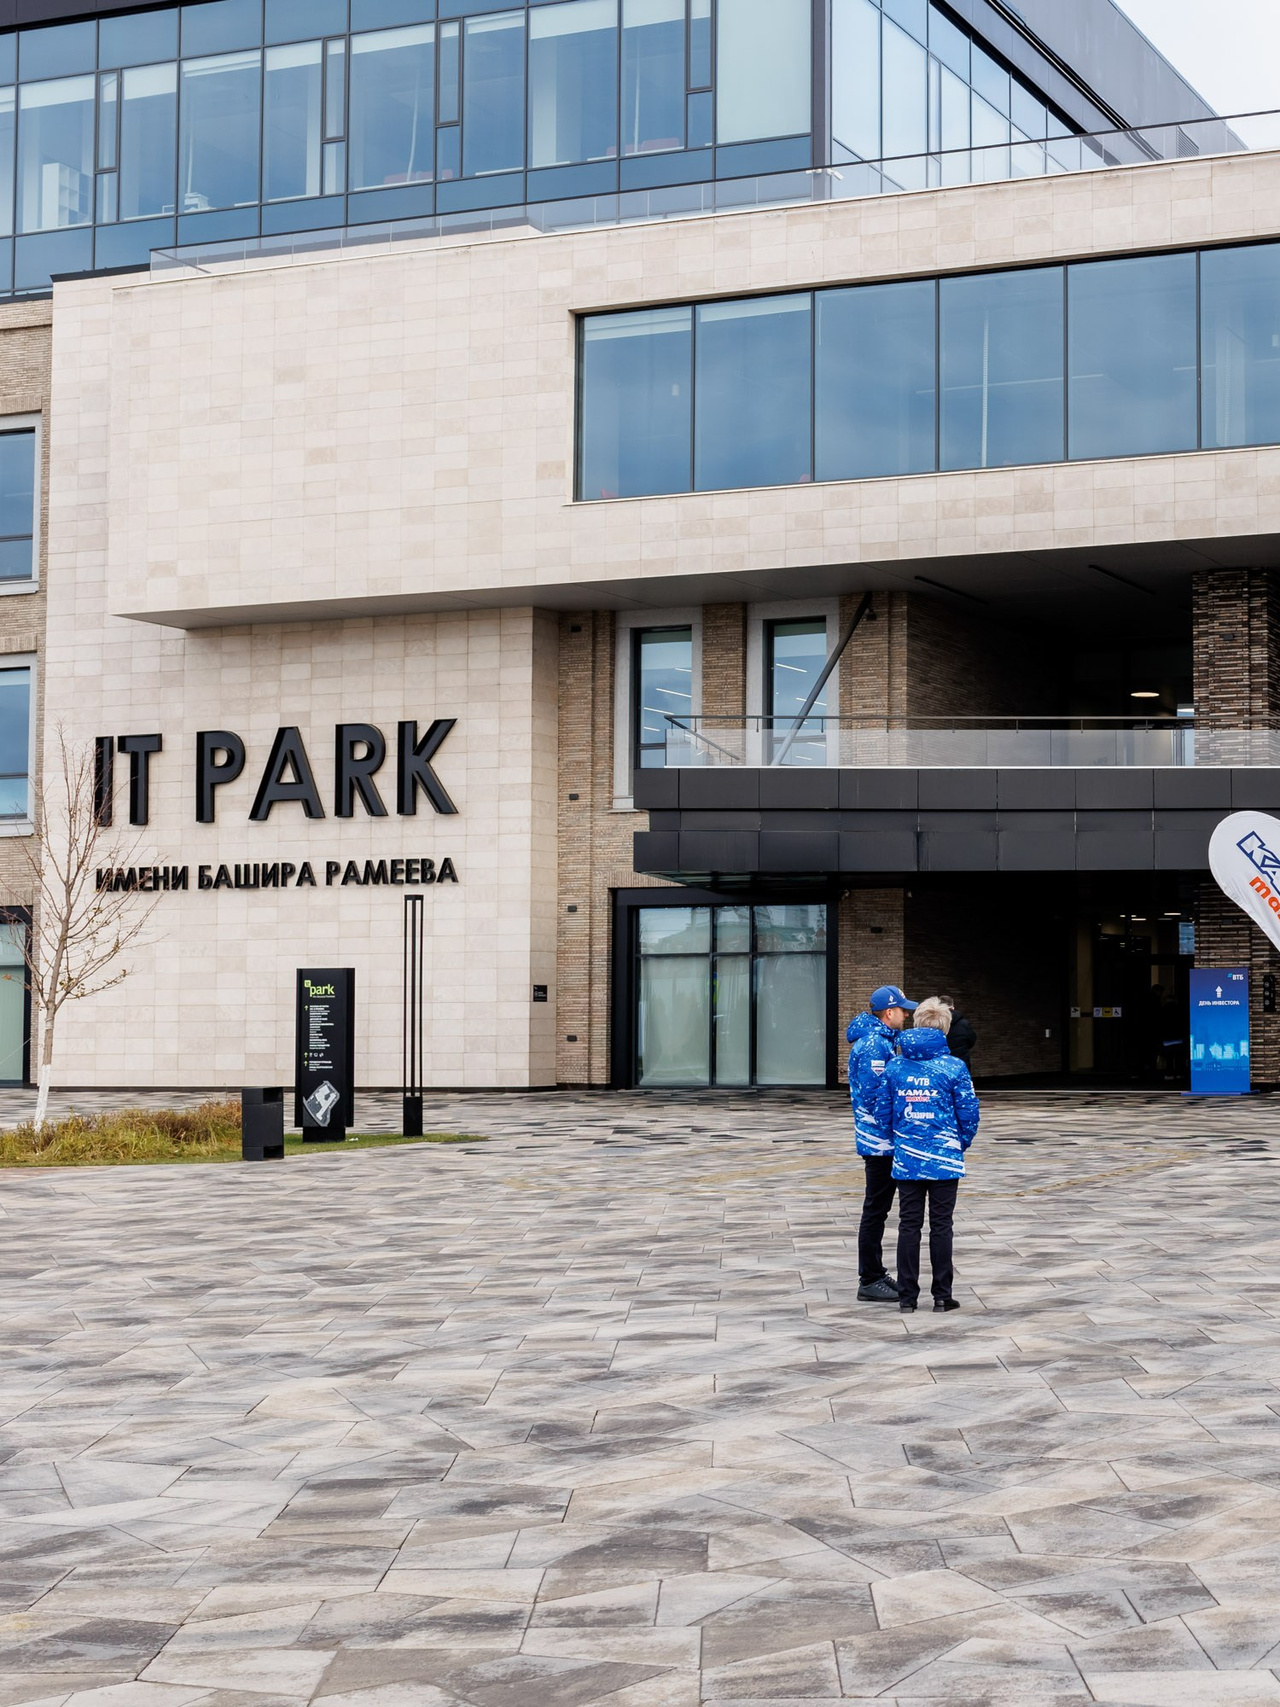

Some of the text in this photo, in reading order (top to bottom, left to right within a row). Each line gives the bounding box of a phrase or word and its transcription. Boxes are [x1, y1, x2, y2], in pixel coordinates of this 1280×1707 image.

[94, 718, 459, 827] IT PARK
[95, 857, 459, 892] ИМЕНИ БАШИРА РАМЕЕВА
[309, 984, 335, 998] park
[914, 1077, 930, 1086] VTB
[897, 1089, 939, 1097] KAMAZ
